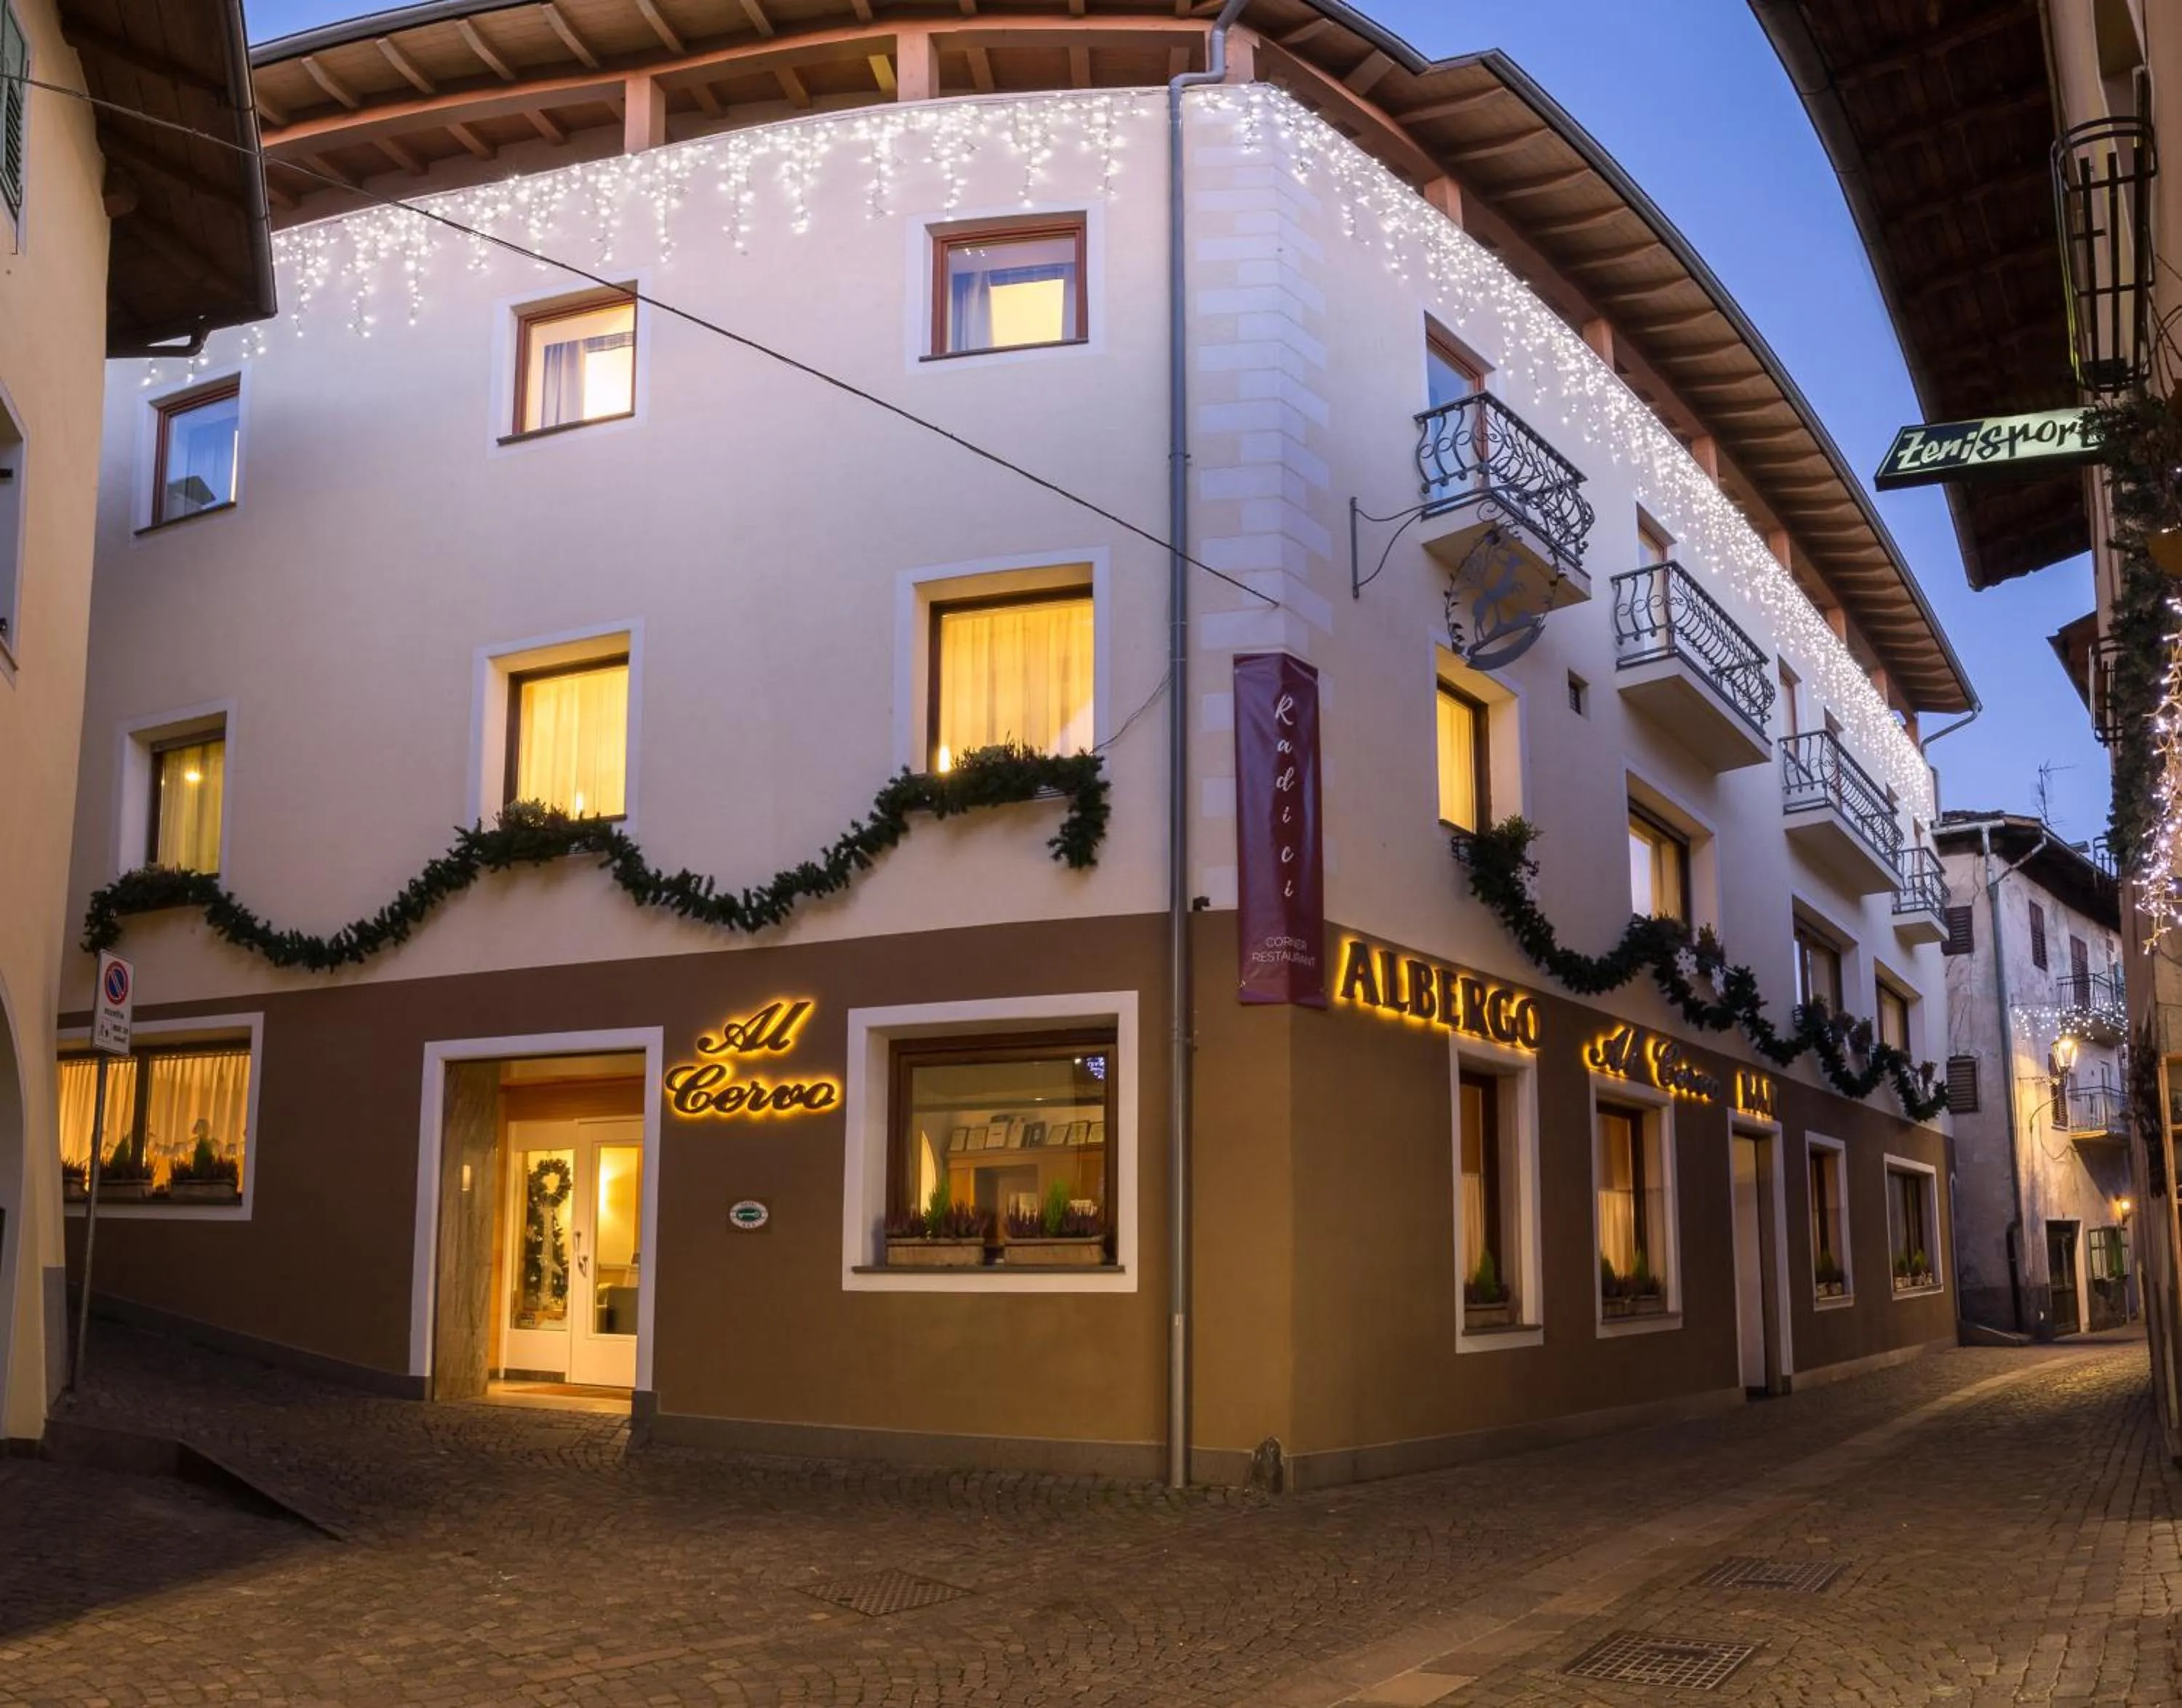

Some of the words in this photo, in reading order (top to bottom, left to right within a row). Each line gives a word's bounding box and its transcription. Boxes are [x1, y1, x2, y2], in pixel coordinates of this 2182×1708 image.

[1274, 695, 1295, 897] Radici
[1252, 951, 1316, 967] RESTAURANT
[1340, 941, 1543, 1050] ALBERGO
[696, 1001, 812, 1054] Al
[665, 1063, 836, 1114] Cervo
